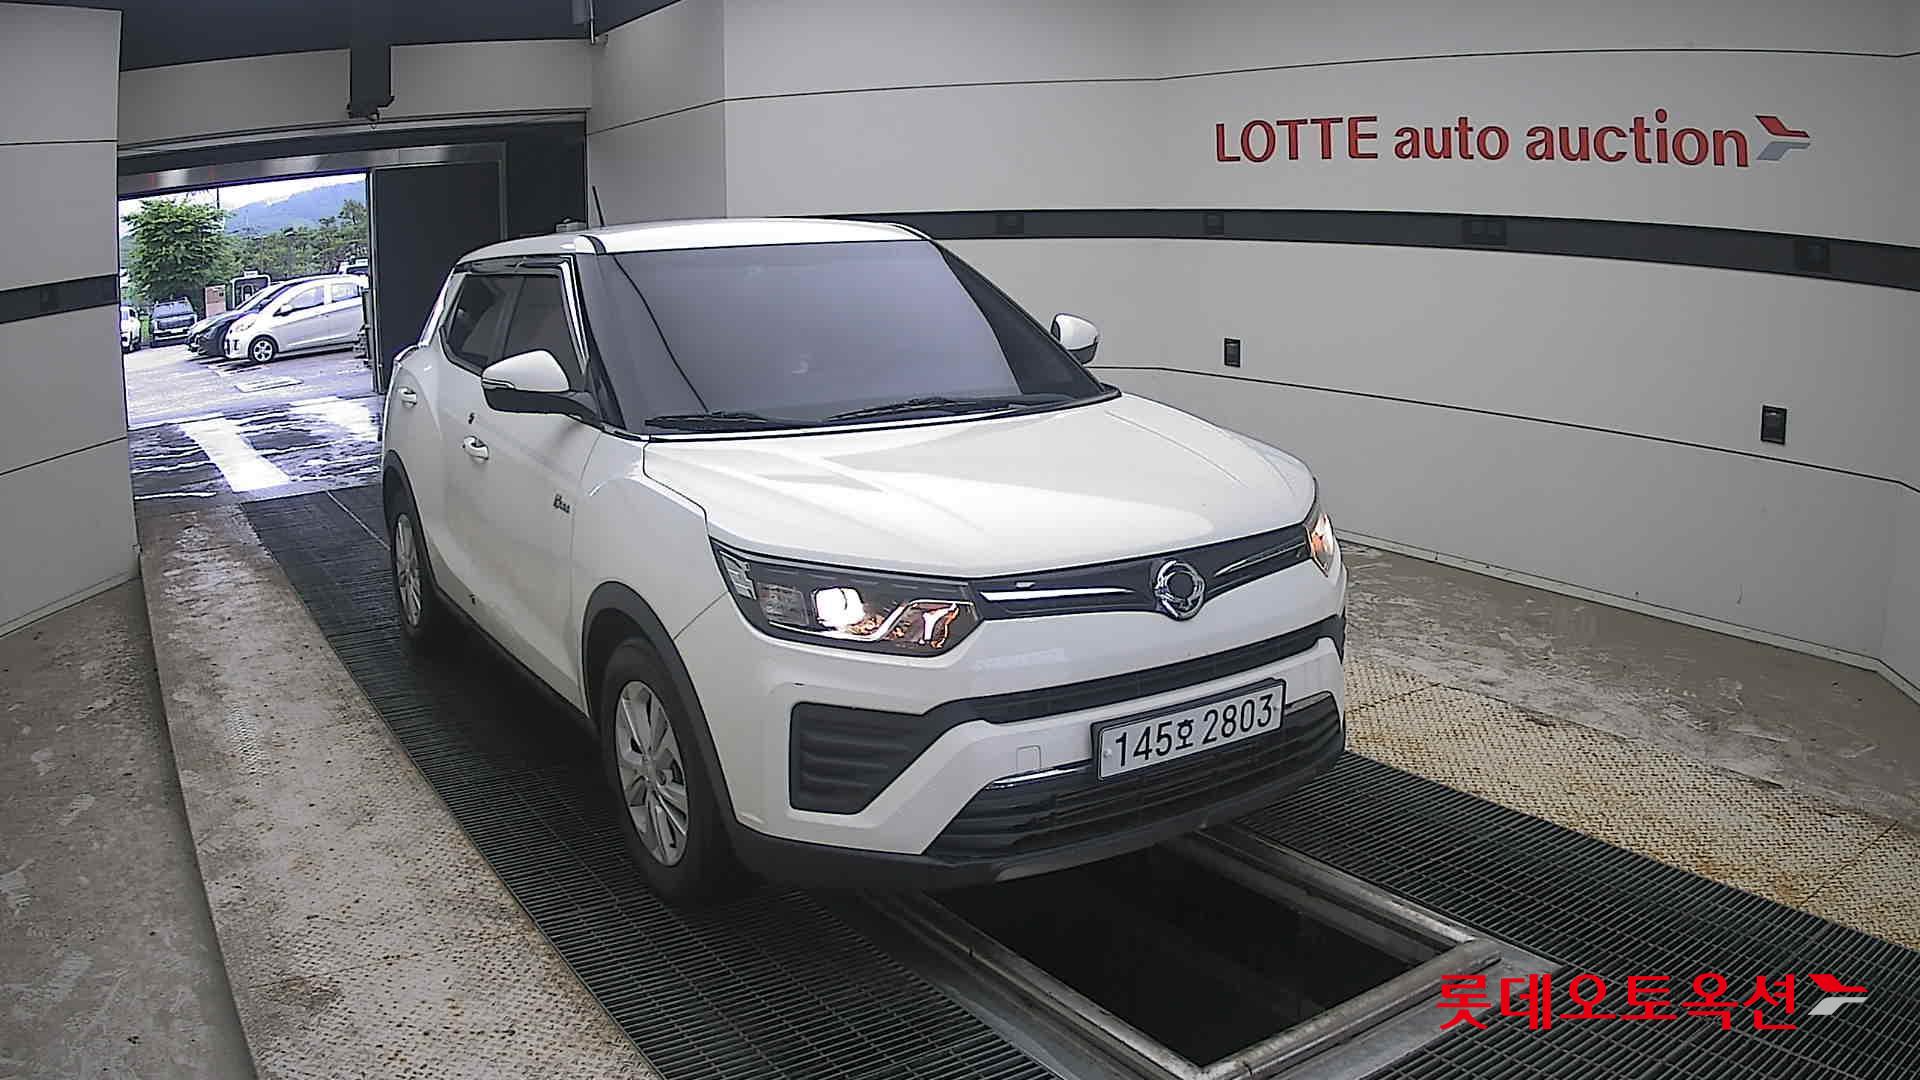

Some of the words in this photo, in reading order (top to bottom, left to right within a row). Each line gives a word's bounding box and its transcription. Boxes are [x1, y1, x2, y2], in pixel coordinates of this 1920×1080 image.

[1215, 116, 1378, 162] LOTTE
[1394, 116, 1509, 161] auto
[1525, 109, 1748, 167] auction
[1202, 694, 1273, 745] 2803
